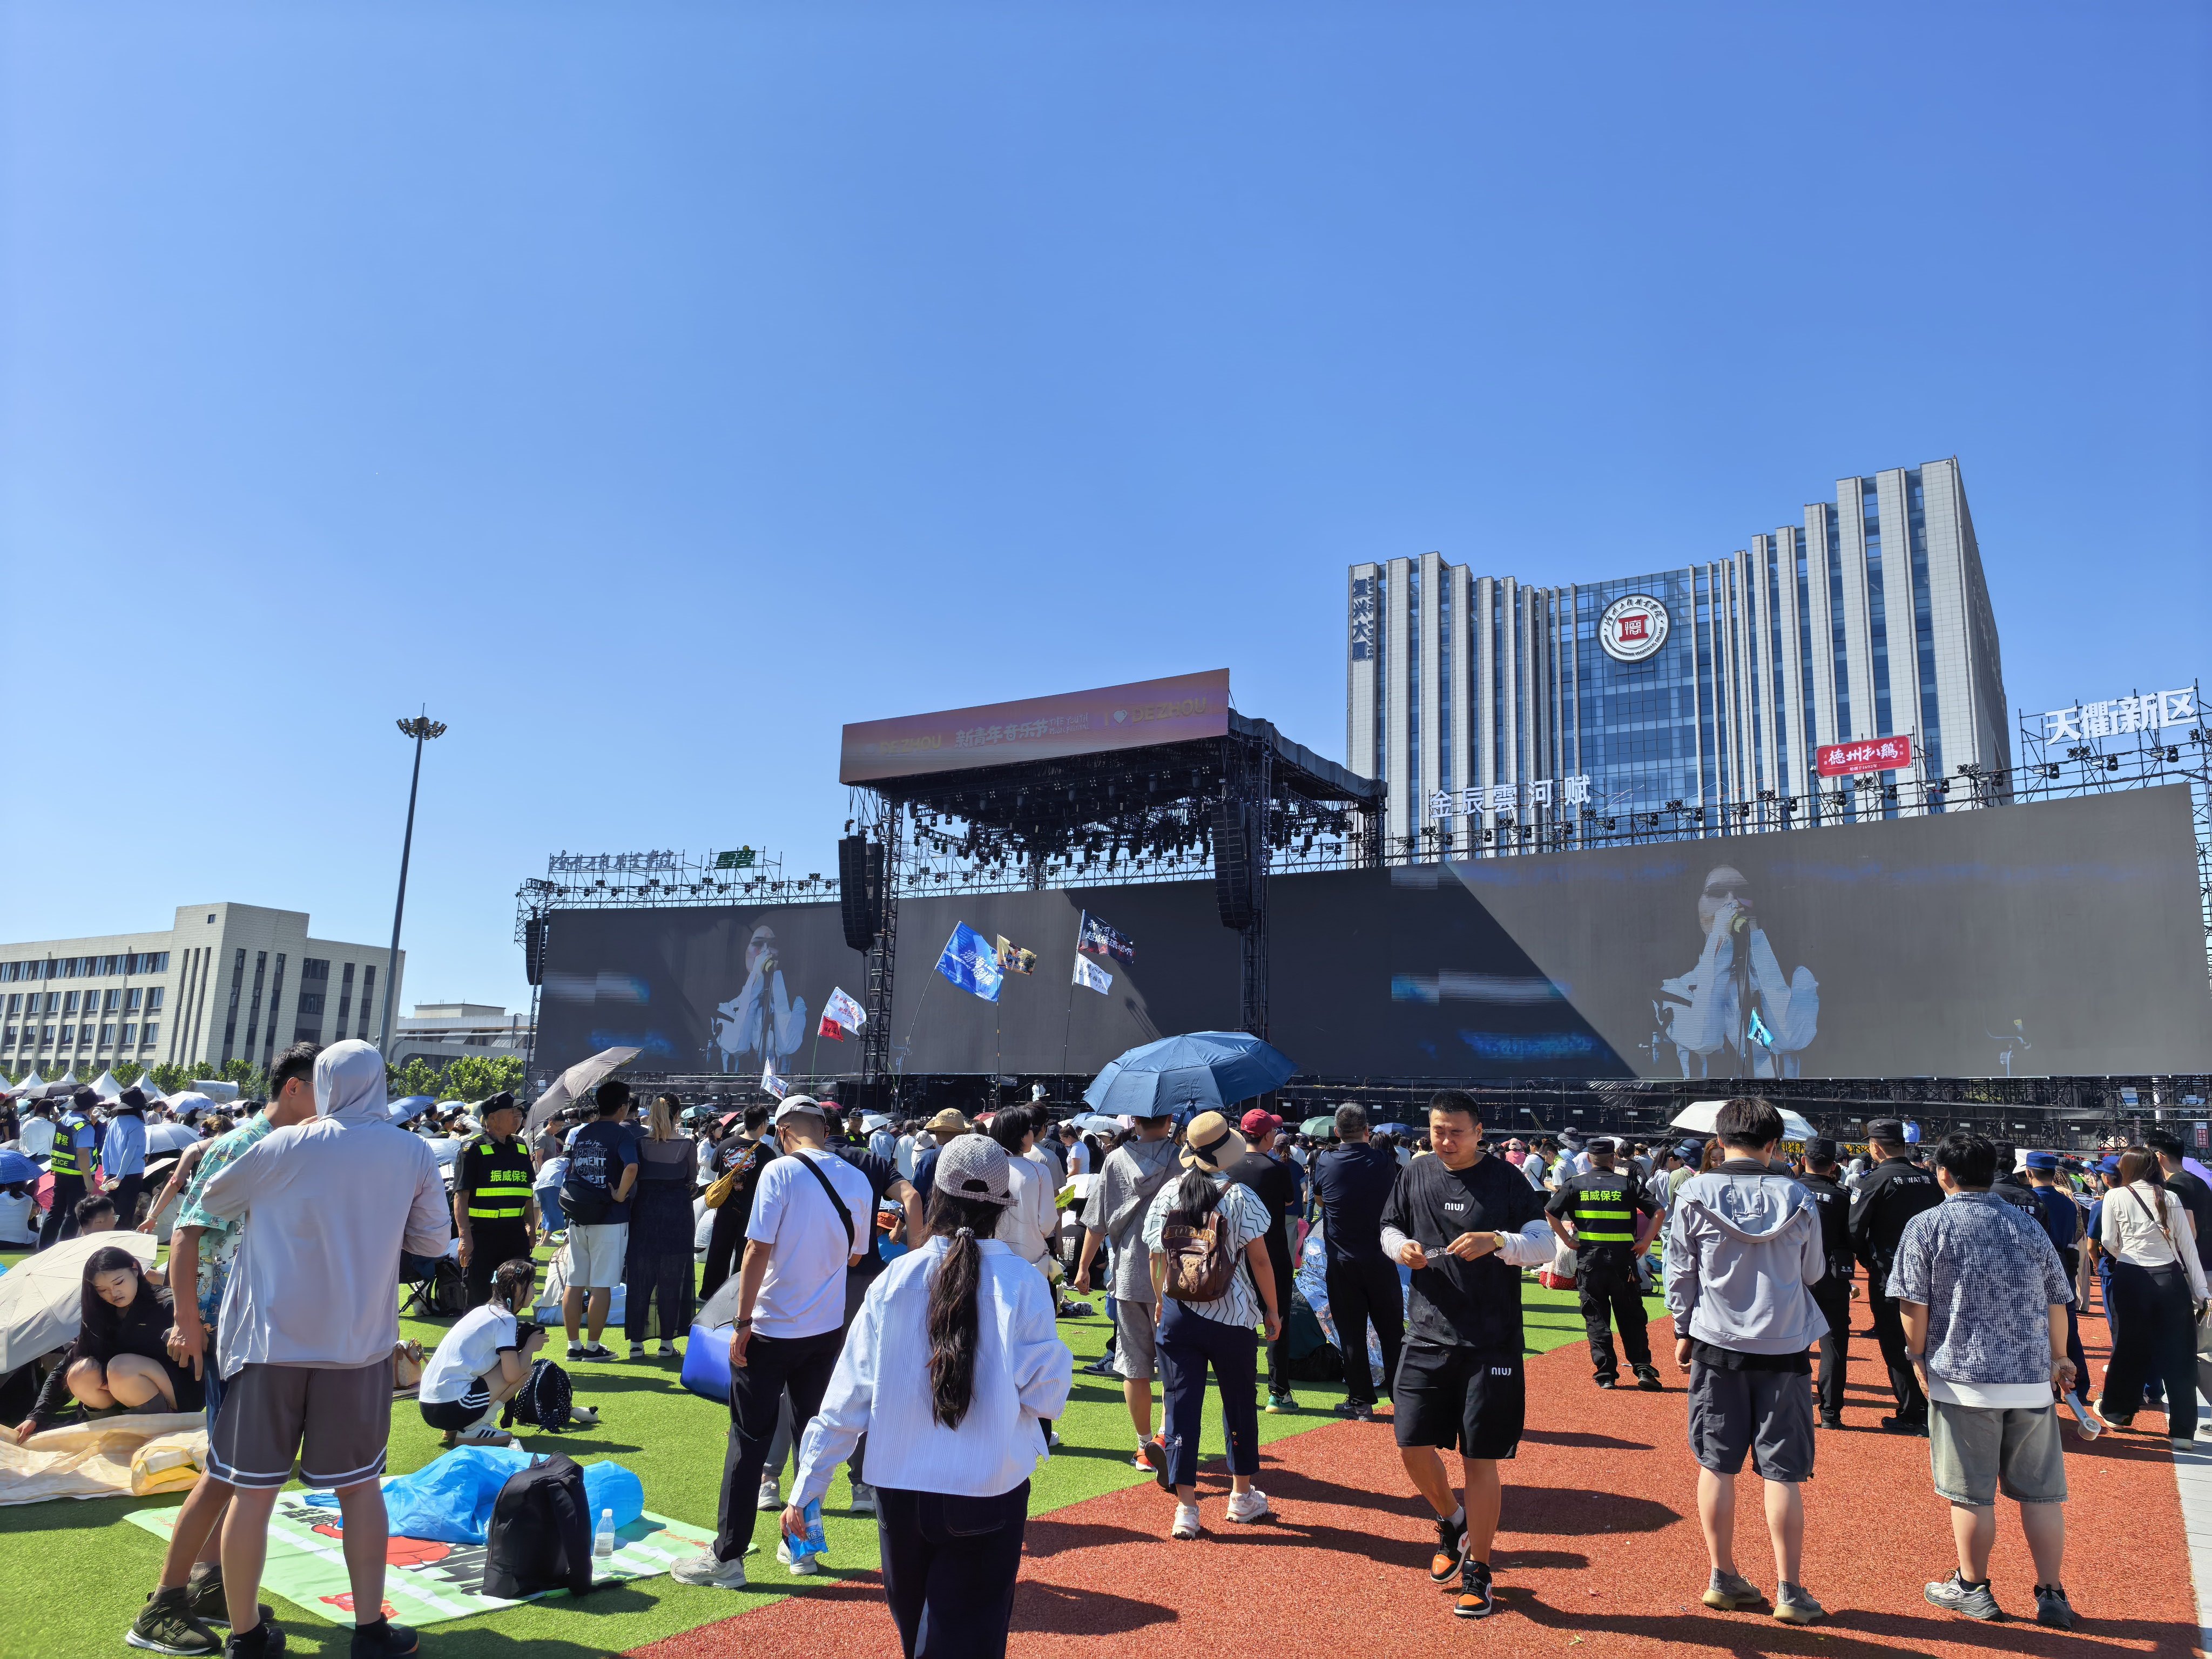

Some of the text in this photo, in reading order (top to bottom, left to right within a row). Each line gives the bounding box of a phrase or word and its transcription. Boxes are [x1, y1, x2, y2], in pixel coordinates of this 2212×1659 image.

[1635, 642, 1656, 656] VOCATIONAL
[2045, 686, 2197, 746] 天衢新区
[955, 718, 1048, 748] 新青年音乐节
[55, 1132, 69, 1146] 警察
[575, 1147, 607, 1157] OMENT
[51, 1157, 69, 1166] OLICE
[490, 1170, 527, 1182] 振威保安
[576, 1166, 606, 1175] OMENT
[1893, 1176, 1903, 1185] 特
[1580, 1190, 1622, 1202] 振威保安
